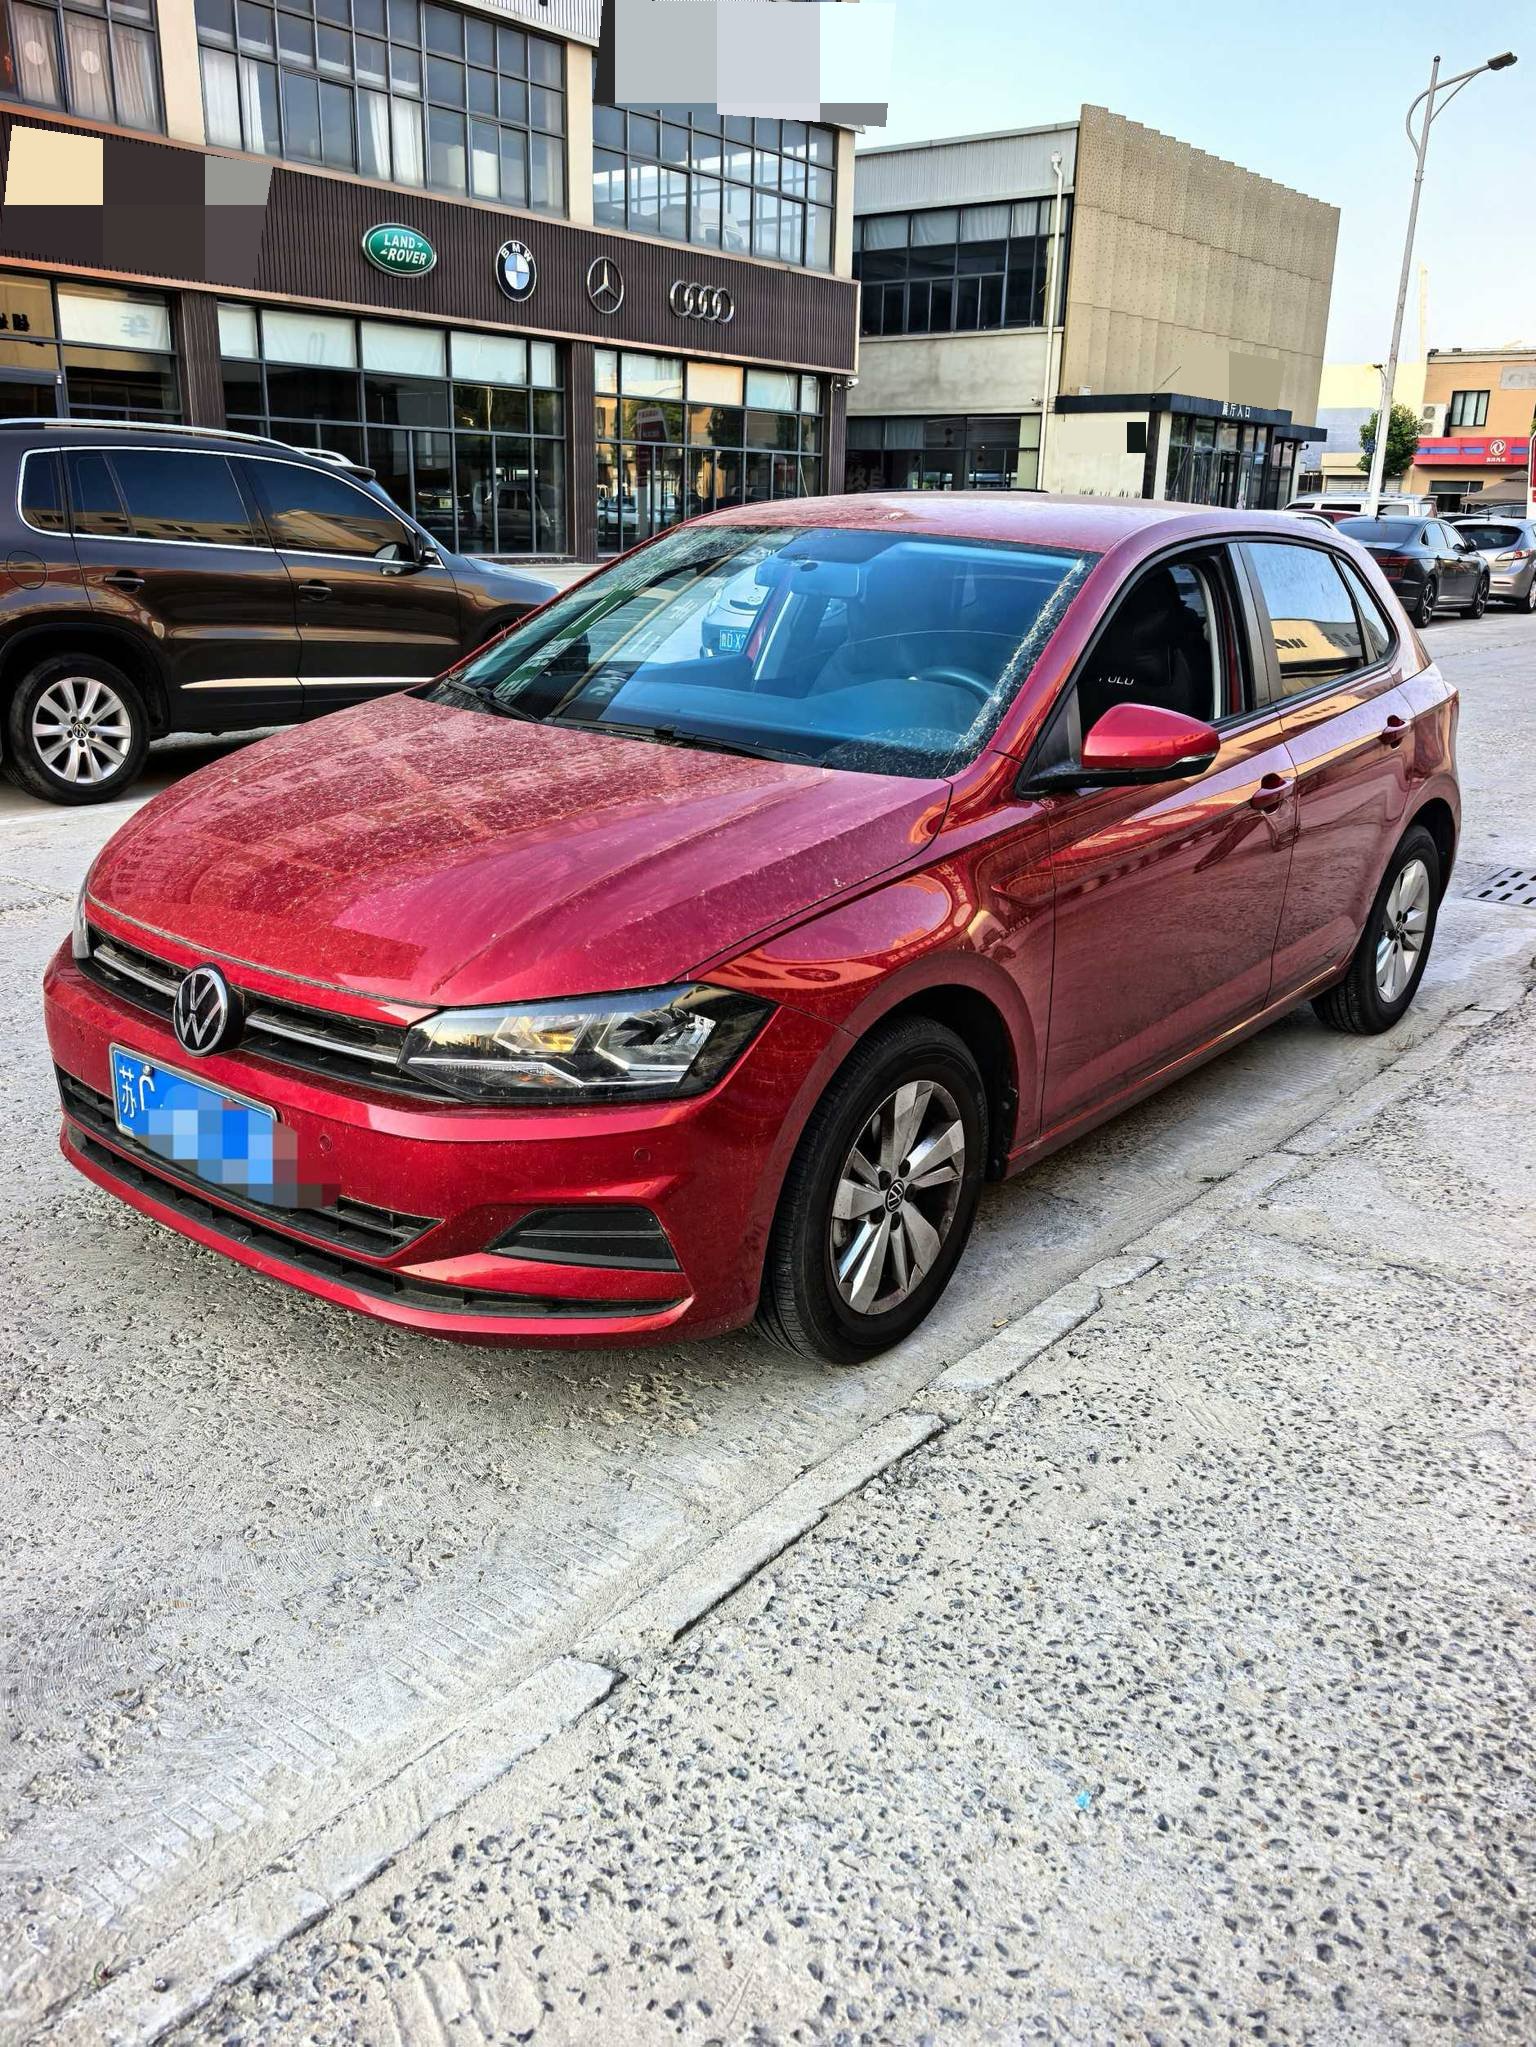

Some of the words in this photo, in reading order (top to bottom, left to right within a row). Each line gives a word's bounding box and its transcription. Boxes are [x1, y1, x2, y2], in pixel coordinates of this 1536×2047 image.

[384, 233, 416, 249] LAND
[387, 247, 427, 266] ROVER
[500, 242, 532, 262] BMW
[1222, 402, 1251, 418] 展厅入口
